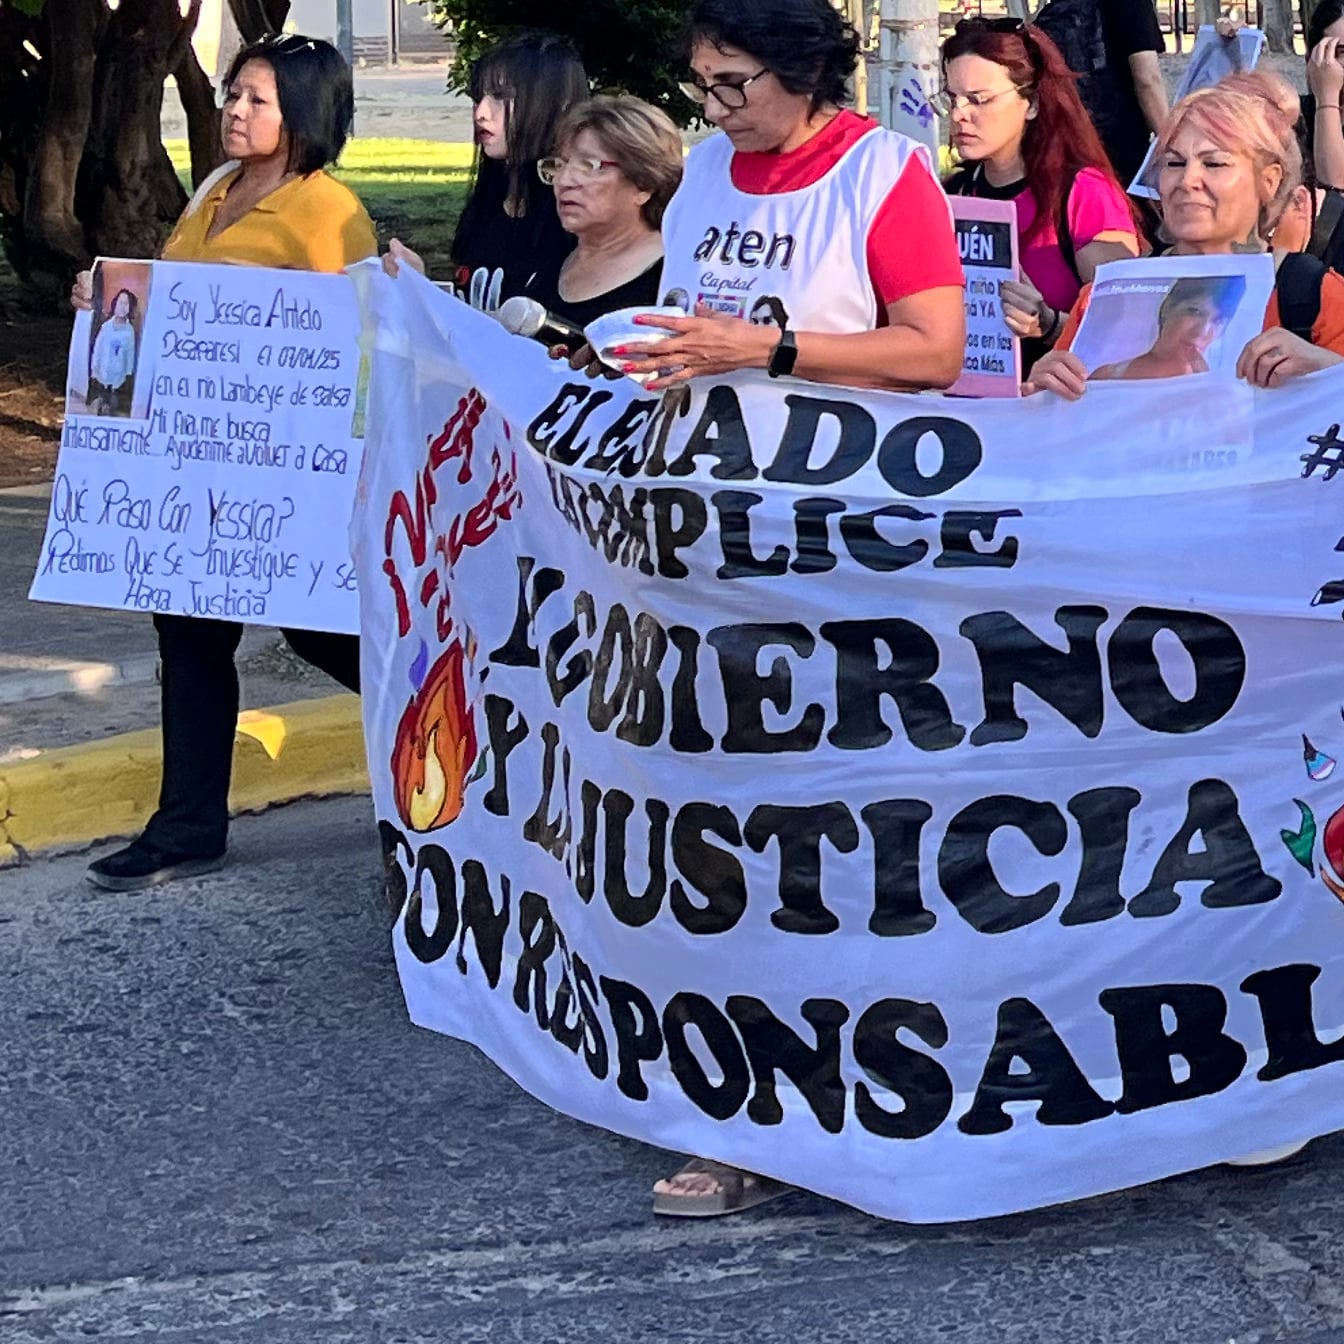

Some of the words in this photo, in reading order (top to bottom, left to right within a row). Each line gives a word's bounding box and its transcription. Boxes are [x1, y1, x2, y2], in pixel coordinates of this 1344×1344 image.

[694, 220, 797, 271] aten
[700, 271, 759, 293] Capital
[166, 281, 198, 336] Soy
[980, 301, 997, 319] YA
[290, 380, 308, 406] de
[546, 589, 1247, 754] GOBIERNO
